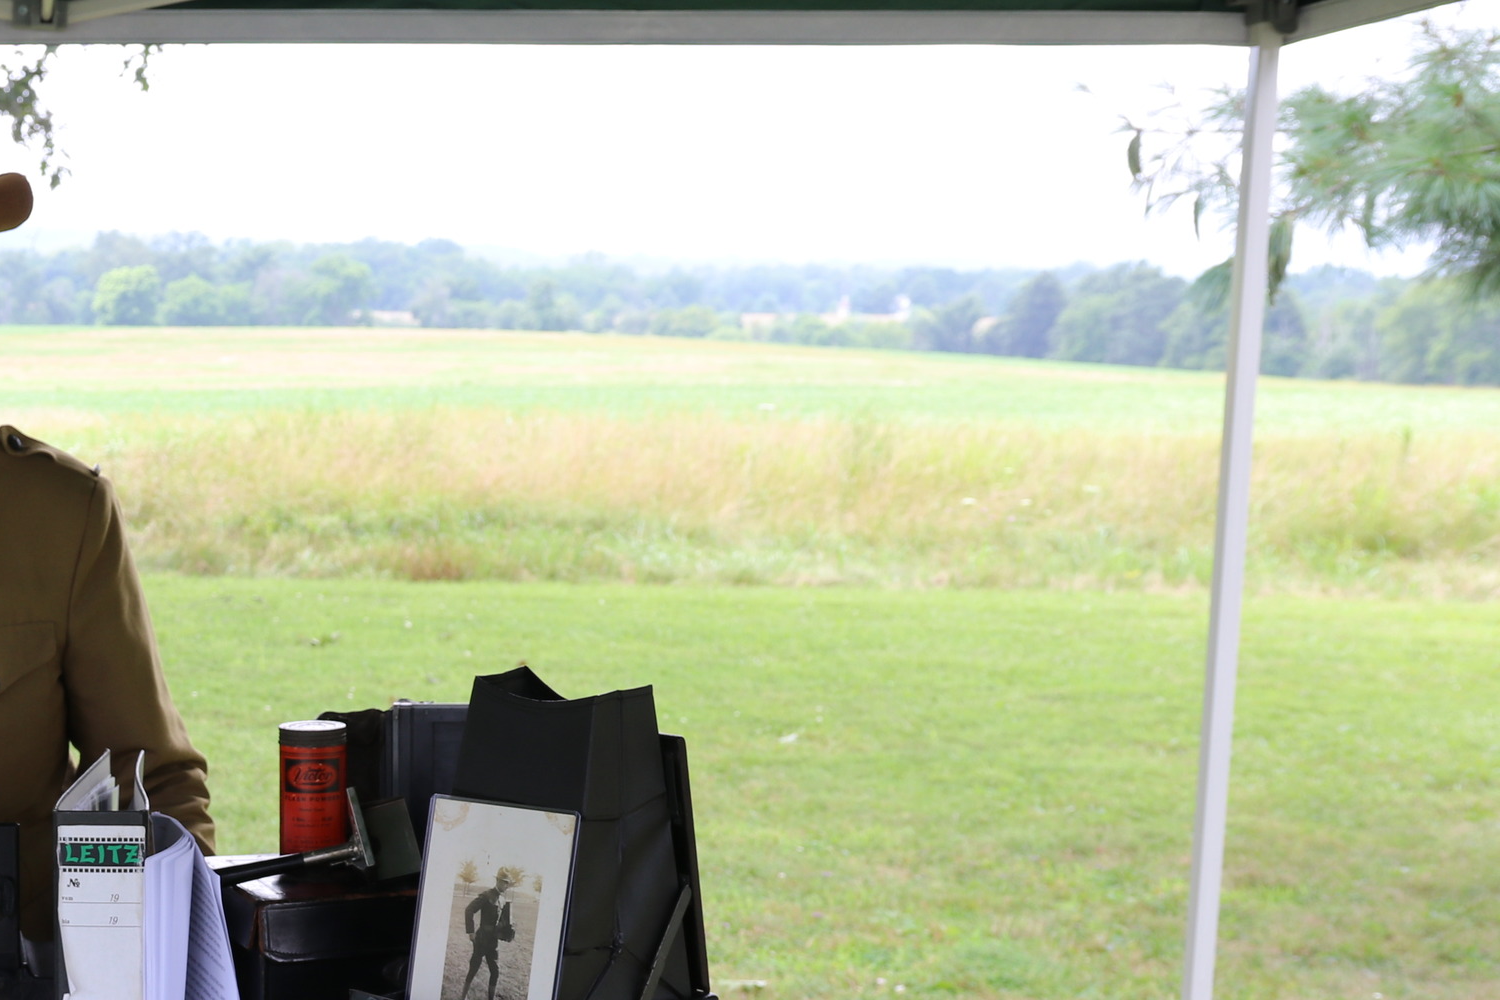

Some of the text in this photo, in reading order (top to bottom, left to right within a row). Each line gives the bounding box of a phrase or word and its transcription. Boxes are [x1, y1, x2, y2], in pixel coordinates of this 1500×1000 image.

[65, 844, 141, 864] LEITZ
[110, 893, 120, 902] 19
[108, 916, 118, 925] 19
